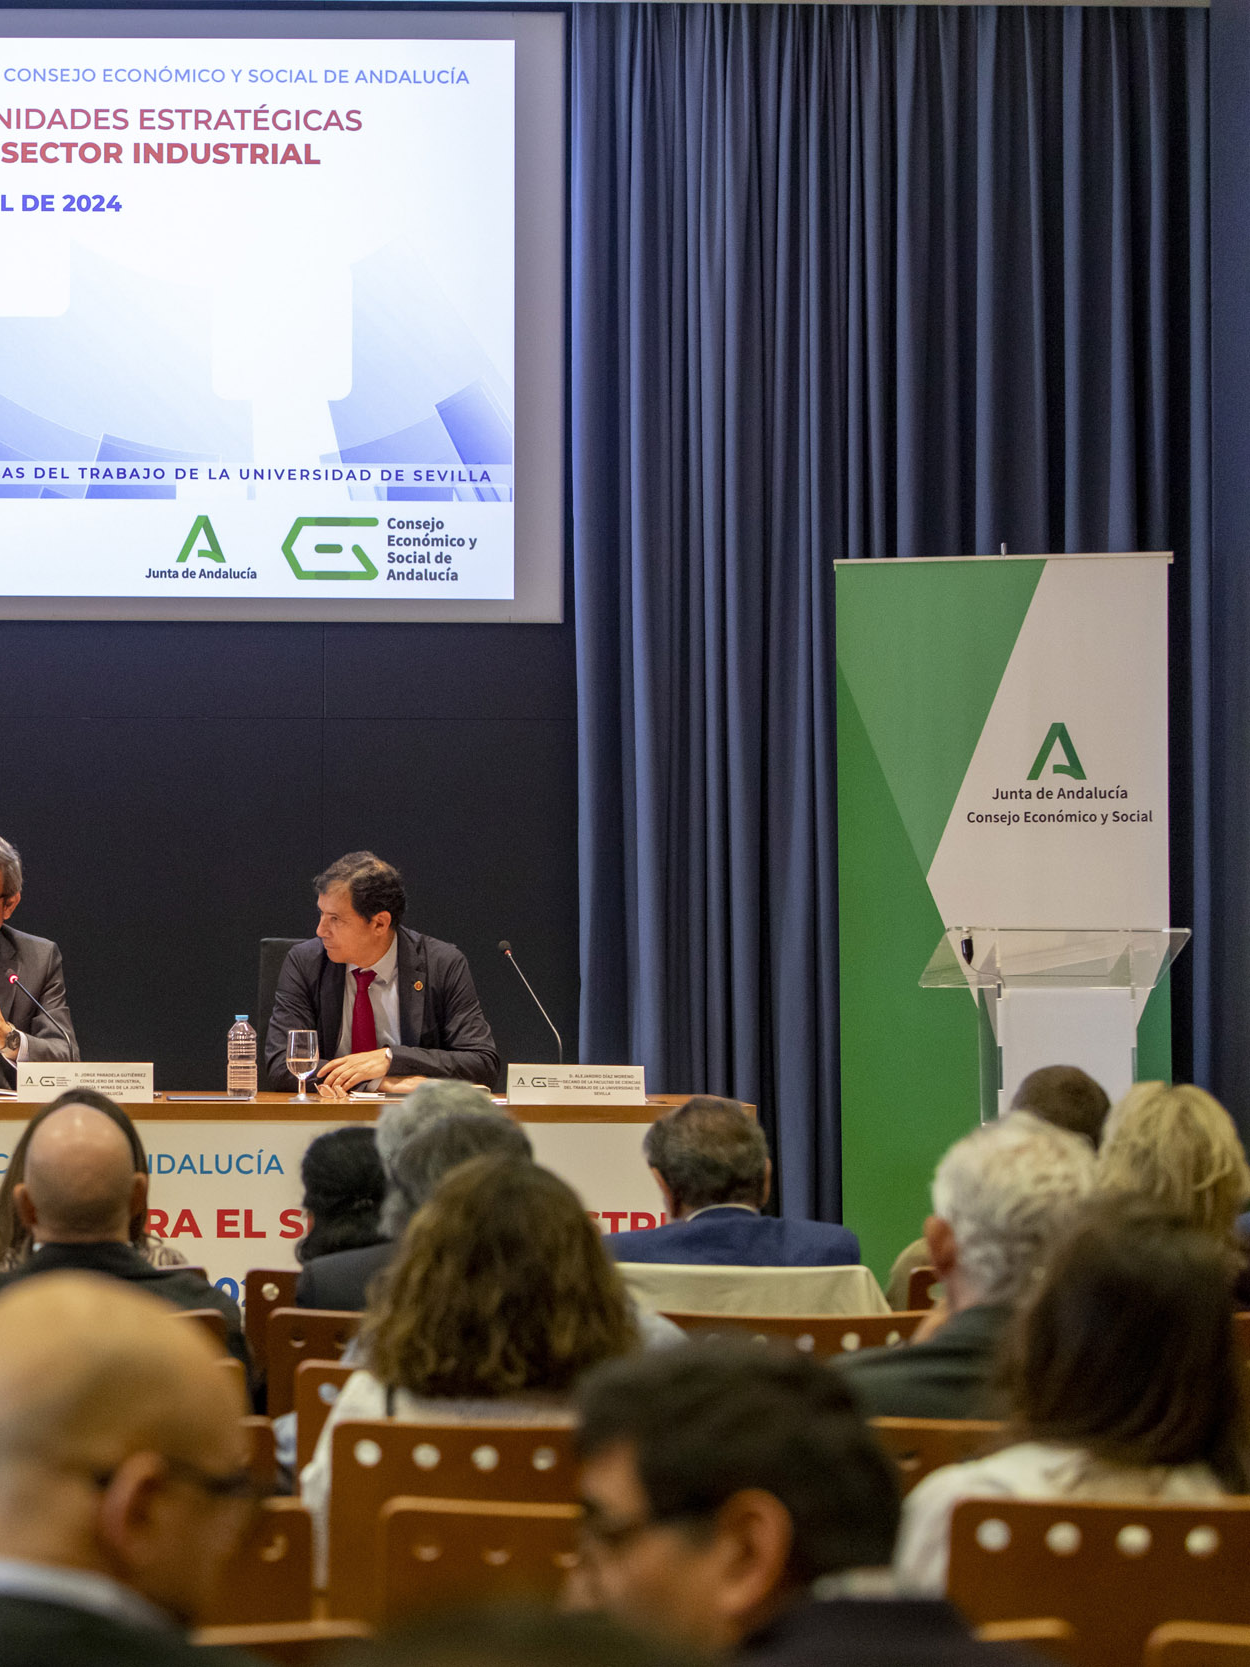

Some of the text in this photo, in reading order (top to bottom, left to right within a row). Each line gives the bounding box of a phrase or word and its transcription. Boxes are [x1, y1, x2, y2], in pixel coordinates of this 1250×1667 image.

[3, 67, 97, 82] CONSEJO
[102, 65, 226, 83] ECONÓMICO
[230, 68, 243, 83] Y
[248, 68, 319, 84] SOCIAL
[324, 69, 350, 84] DE
[354, 66, 470, 85] ANDALUCÍA
[139, 103, 363, 132] ESTRATÉGICAS
[0, 141, 123, 164] SECTOR
[133, 142, 322, 165] INDUSTRIAL
[21, 193, 55, 212] DE
[61, 193, 123, 212] 2024
[33, 467, 70, 480] DEL
[77, 467, 166, 480] TRABAJO
[174, 468, 200, 480] DE
[207, 468, 231, 480] LA
[238, 468, 373, 481] UNIVERSIDAD
[380, 469, 405, 482] DE
[412, 469, 493, 483] SEVILLA
[386, 516, 445, 532] Consejo
[386, 532, 478, 551] Económico y
[386, 550, 453, 565] Social de
[144, 567, 258, 580] Junta de Andalucía
[386, 566, 459, 582] Andalucía
[991, 784, 1128, 801] Junta de Andalucía
[966, 809, 1153, 827] Consejo Económico y Social
[216, 1208, 267, 1239] EL
